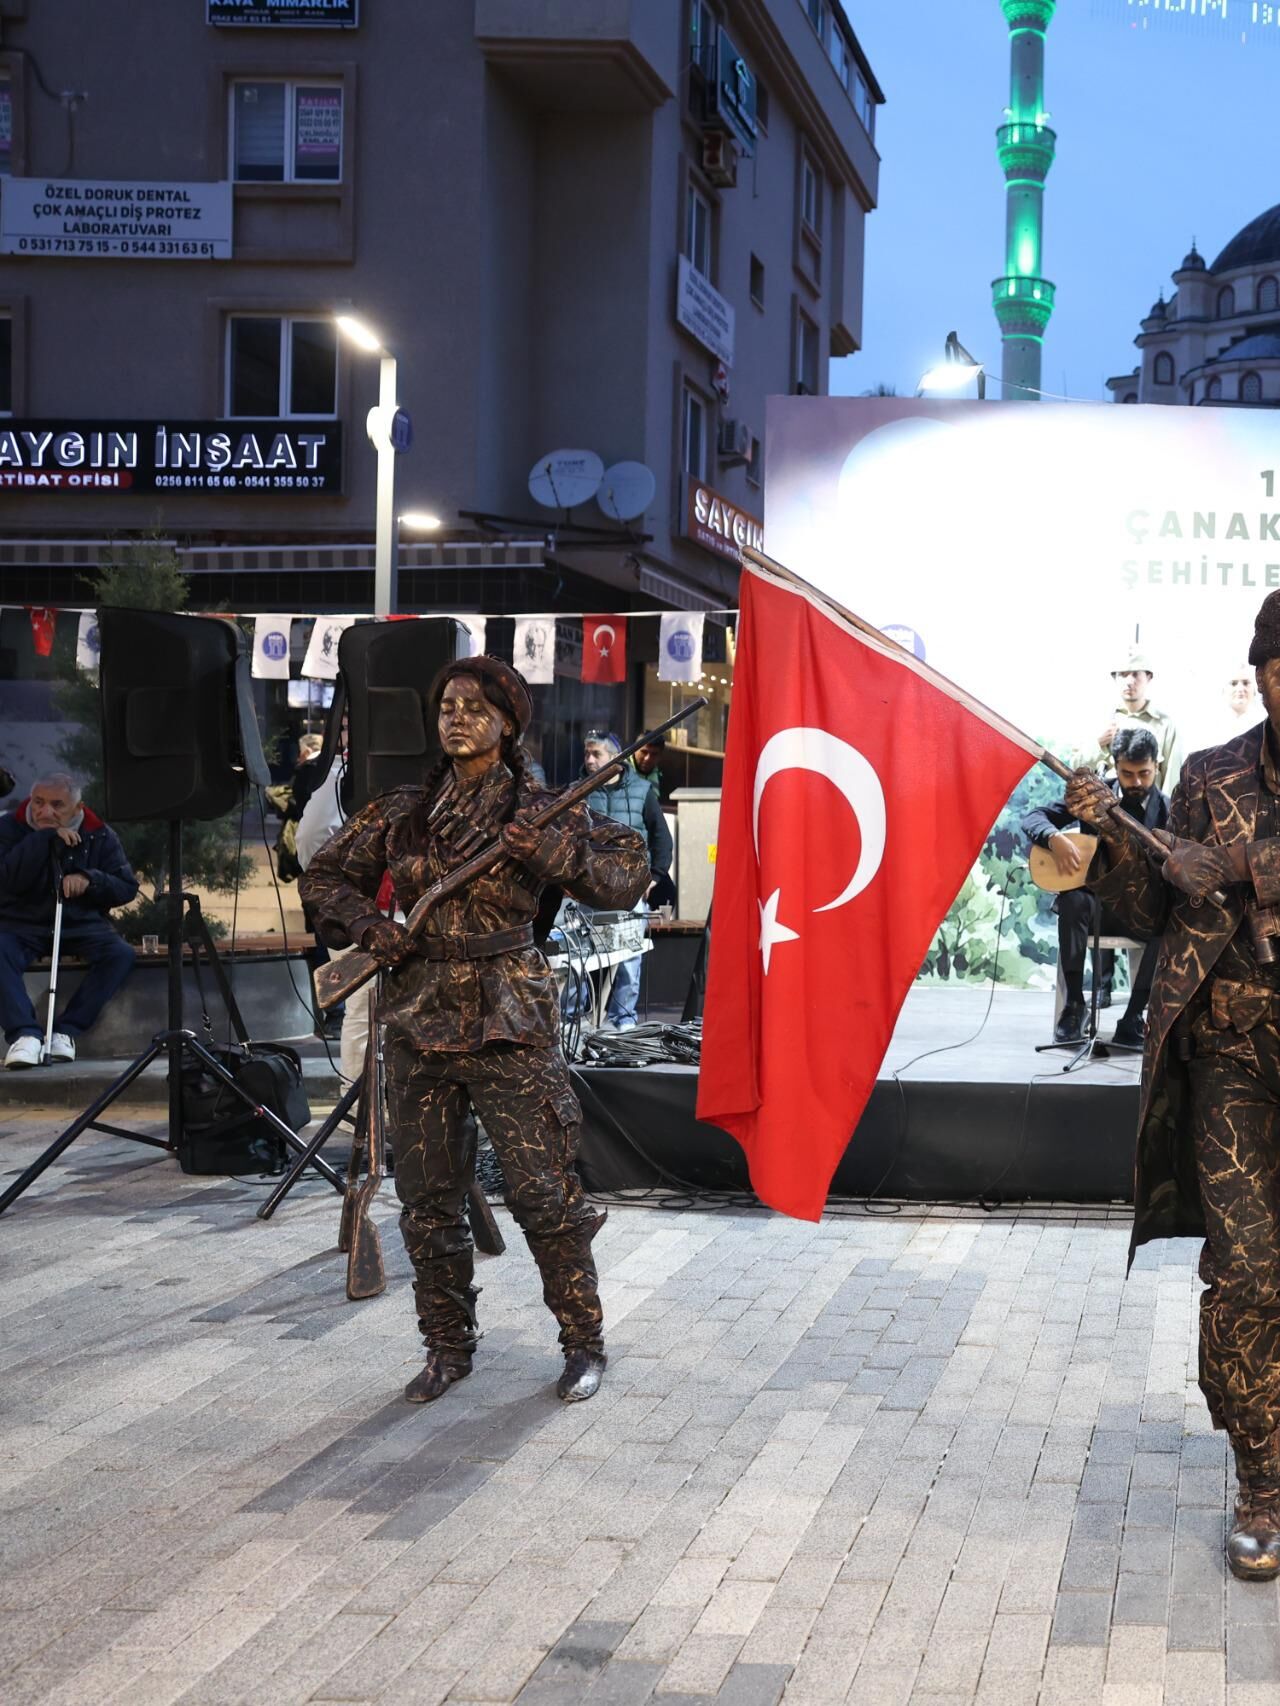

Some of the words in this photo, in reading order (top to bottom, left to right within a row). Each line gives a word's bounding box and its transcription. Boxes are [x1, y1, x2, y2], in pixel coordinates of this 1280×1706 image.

[45, 187, 82, 200] ÖZEL
[85, 188, 134, 201] DORUK
[135, 190, 191, 202] DENTAL
[33, 204, 62, 219] ÇOK
[65, 205, 118, 220] AMAÇLI
[120, 204, 142, 221] DİŞ
[146, 207, 202, 220] PROTEZ
[63, 222, 172, 236] LABORATUVARI
[31, 238, 51, 250] 531
[55, 239, 75, 250] 713
[78, 239, 94, 251] 75
[132, 241, 156, 253] 544
[0, 431, 138, 468] AYGIN
[154, 425, 327, 472] İNŞAAT
[0, 471, 63, 487] TİBAT
[68, 472, 119, 487] OFİSİ
[155, 475, 182, 487] 0256
[184, 475, 204, 487] 811
[207, 475, 221, 487] 65
[222, 476, 236, 487] 66
[244, 476, 271, 487] 0541
[273, 476, 294, 487] 355
[296, 476, 310, 487] 50
[311, 476, 325, 487] 37
